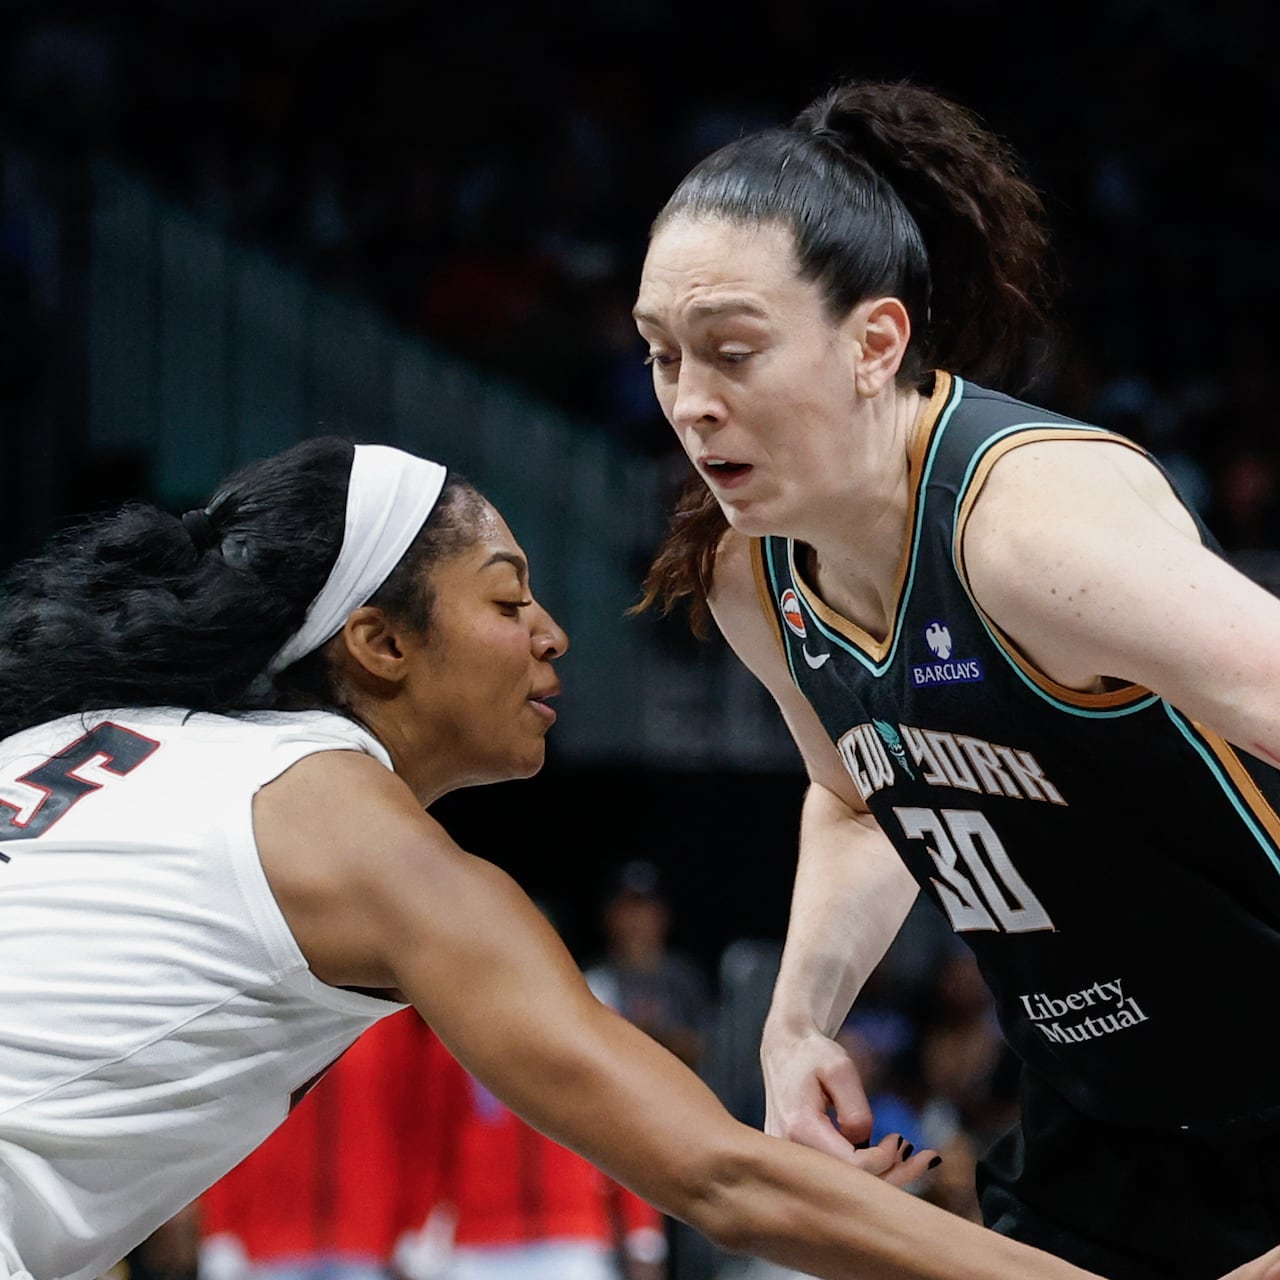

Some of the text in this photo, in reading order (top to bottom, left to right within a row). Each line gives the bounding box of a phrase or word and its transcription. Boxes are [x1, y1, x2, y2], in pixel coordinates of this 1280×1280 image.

[913, 661, 980, 684] BARCLAYS
[837, 723, 1069, 806] EW YORK
[892, 806, 1056, 934] 30
[1019, 978, 1124, 1020] Liberty
[1034, 997, 1149, 1043] Mutual
